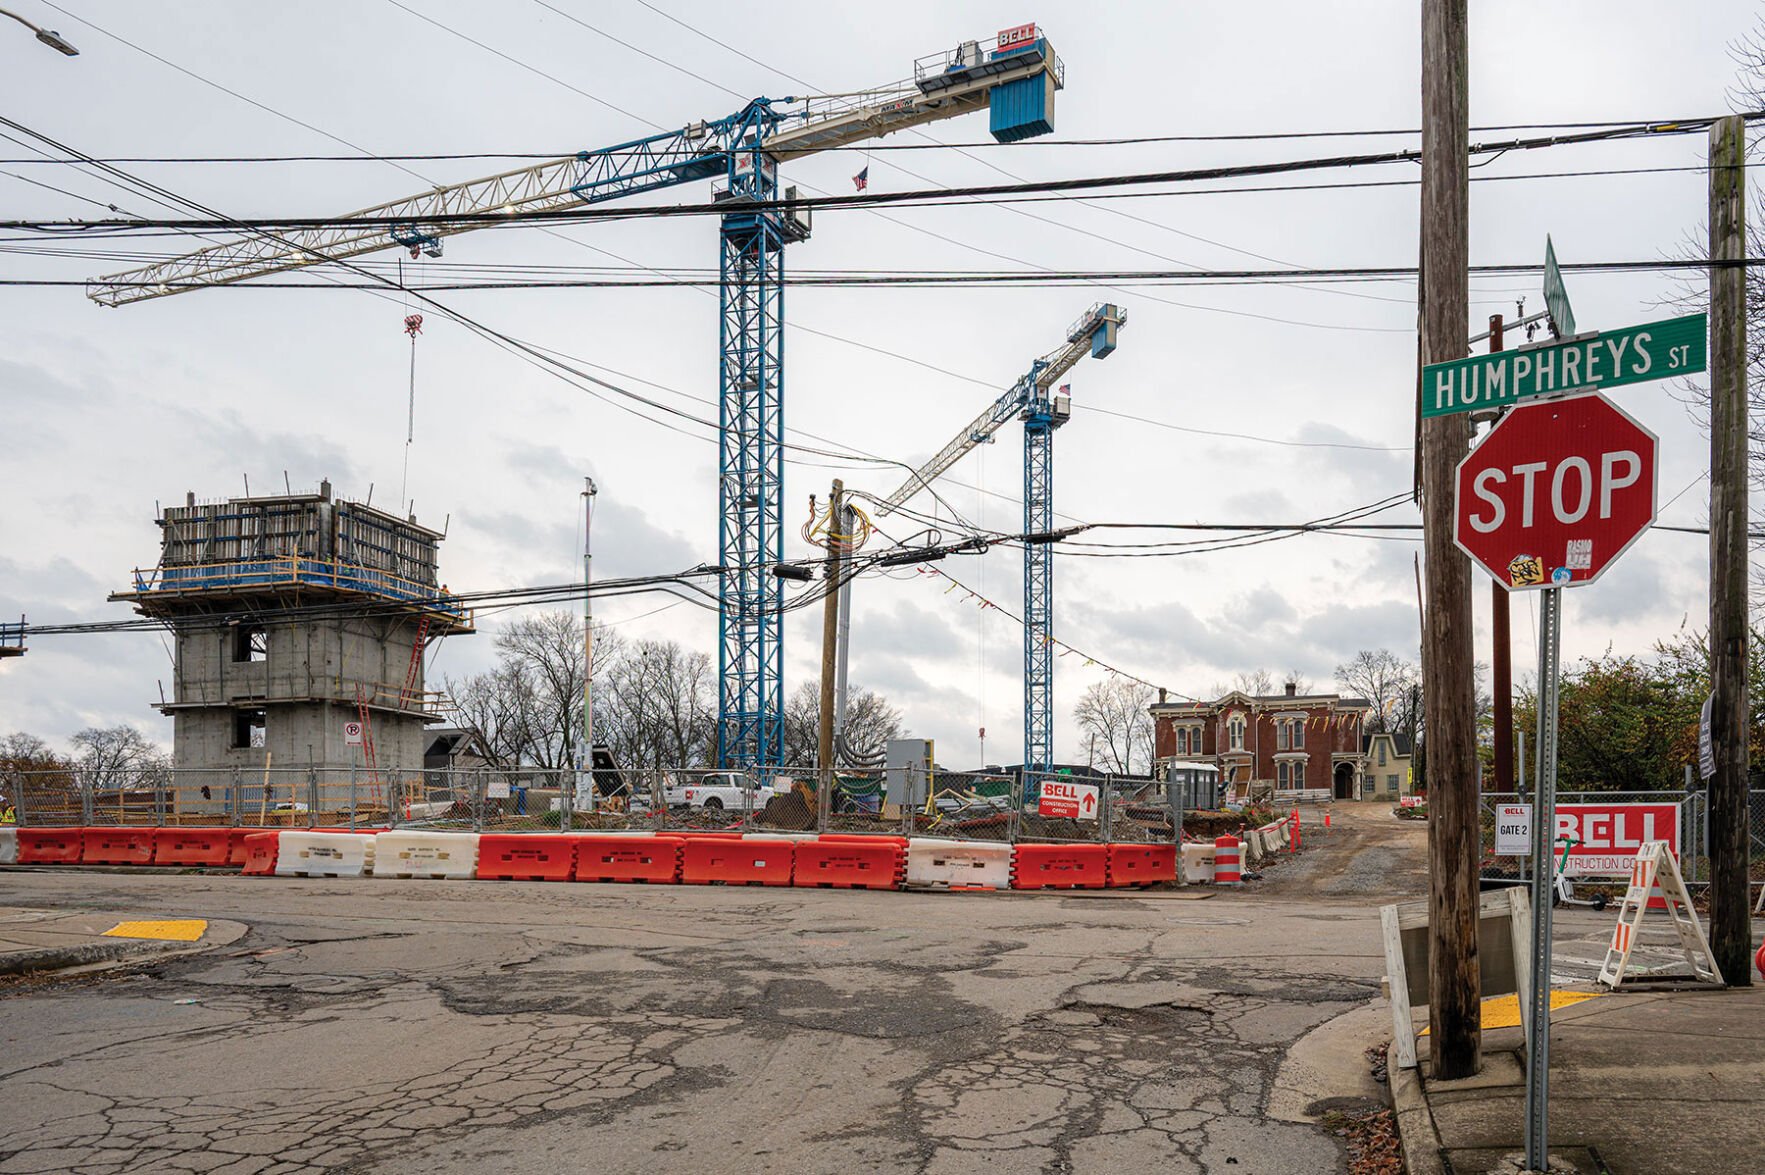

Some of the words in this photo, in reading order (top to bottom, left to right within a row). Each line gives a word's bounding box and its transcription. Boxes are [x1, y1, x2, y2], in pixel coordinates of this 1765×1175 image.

[999, 27, 1033, 46] BELL
[1435, 332, 1653, 409] HUMPHREYS
[1668, 344, 1690, 369] ST
[1468, 450, 1642, 534] STOP
[1043, 783, 1077, 798] BELL
[1041, 800, 1078, 808] CONSTRUCTION
[1504, 807, 1525, 815] BELL
[1500, 825, 1520, 835] GATE
[1522, 825, 1528, 835] 2
[1554, 813, 1669, 848] BELL
[1554, 857, 1618, 869] NTRUCTION
